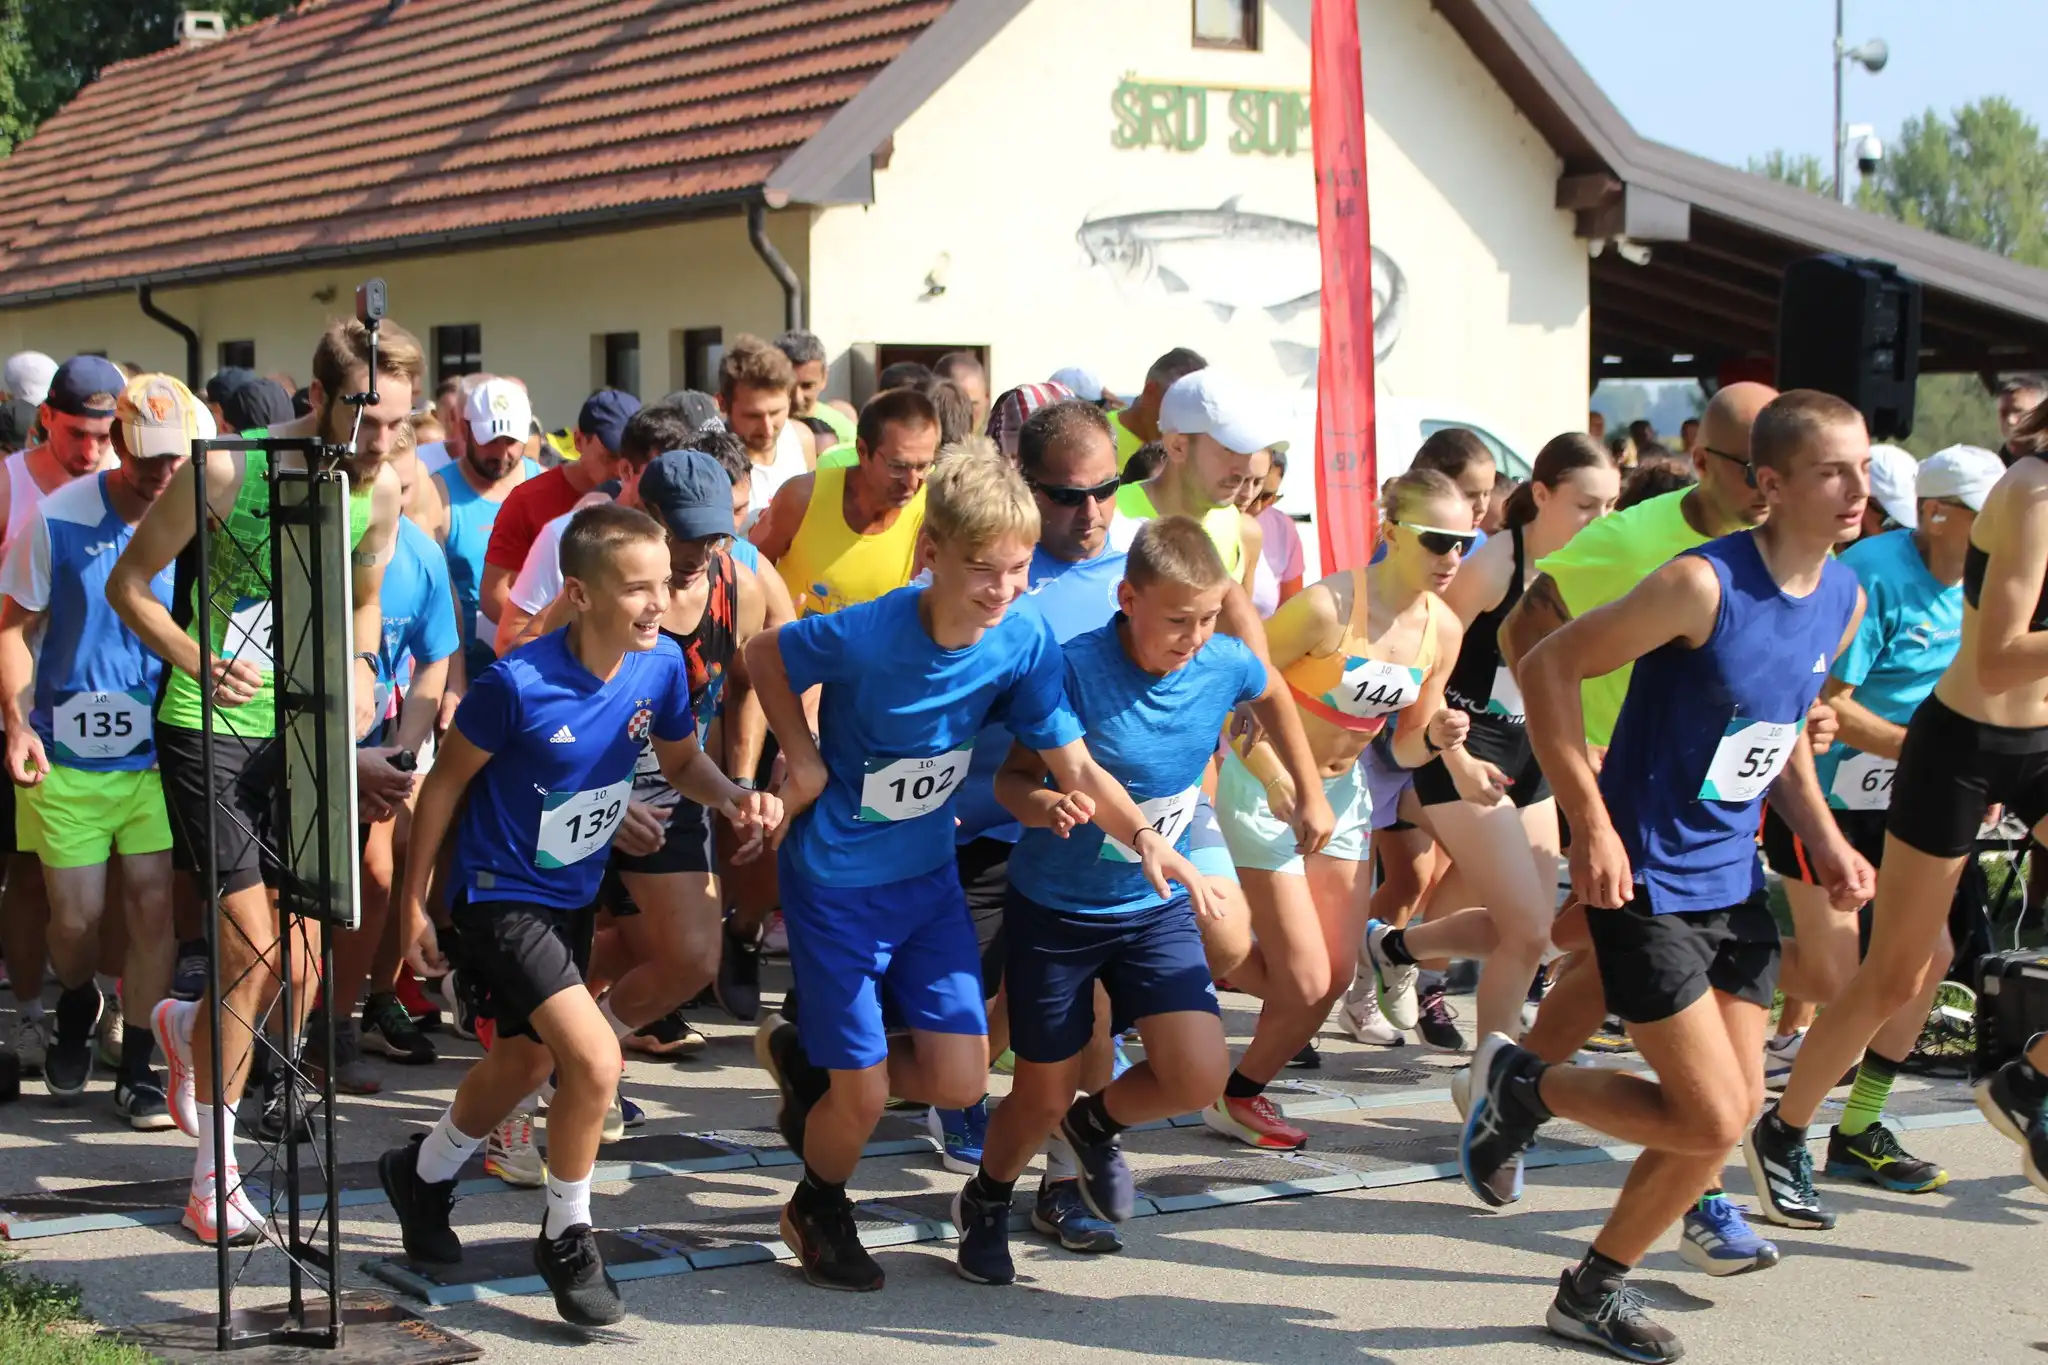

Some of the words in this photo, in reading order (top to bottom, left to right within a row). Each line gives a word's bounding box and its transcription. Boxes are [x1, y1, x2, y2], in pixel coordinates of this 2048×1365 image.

[1352, 680, 1404, 708] 144
[72, 711, 133, 738] 135
[550, 736, 576, 744] adidas
[1737, 746, 1780, 778] 55
[888, 765, 955, 803] 102
[565, 799, 621, 844] 139
